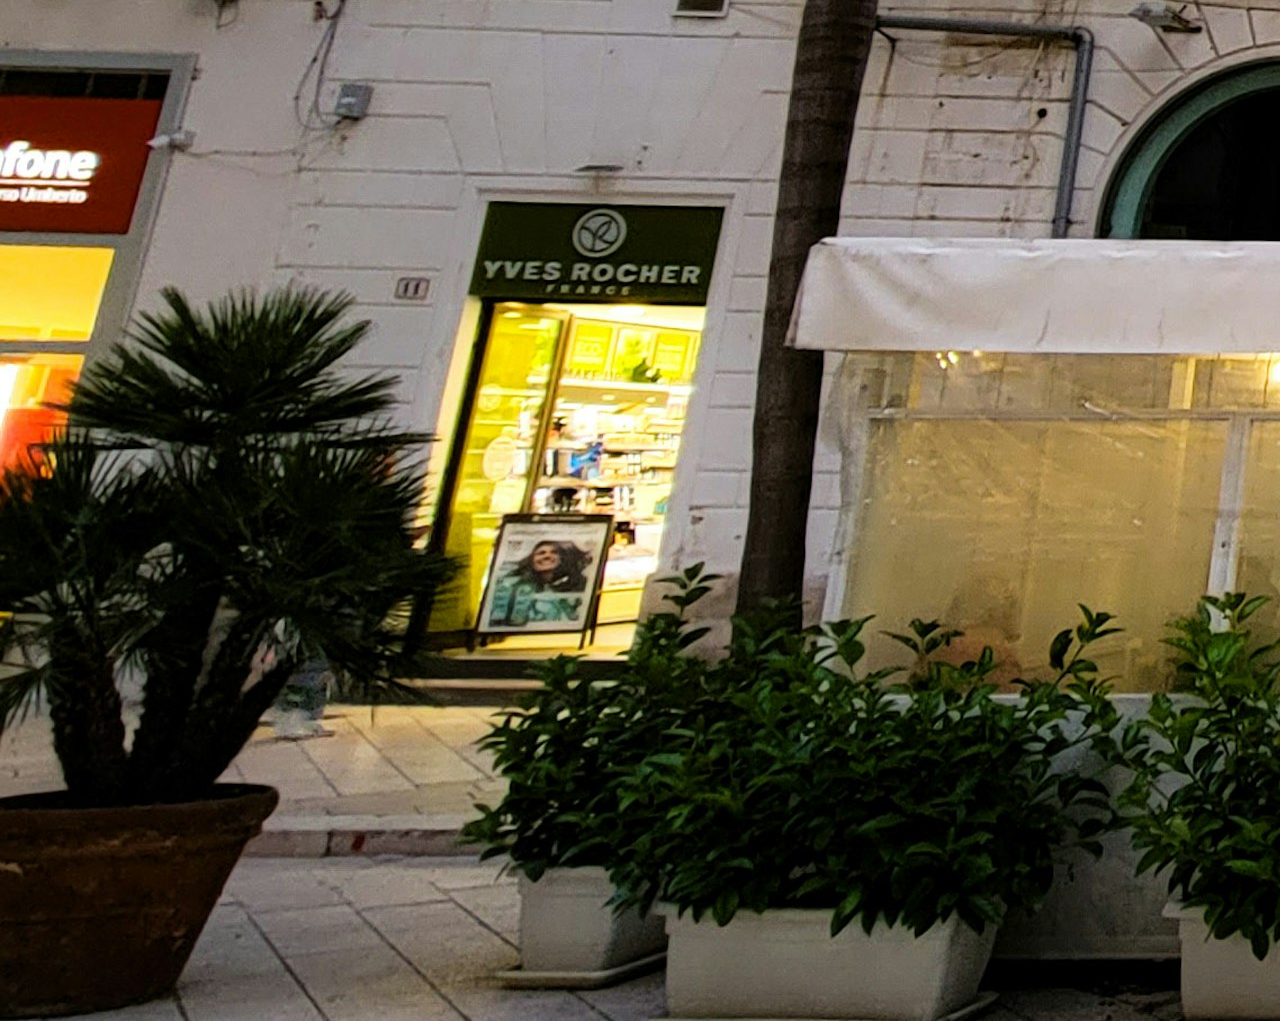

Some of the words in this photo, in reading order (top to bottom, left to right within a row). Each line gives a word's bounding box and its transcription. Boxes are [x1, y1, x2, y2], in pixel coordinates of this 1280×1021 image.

[0, 140, 100, 181] fone
[484, 260, 563, 281] YVES
[571, 262, 701, 285] ROCHER
[545, 284, 632, 296] FRANCE
